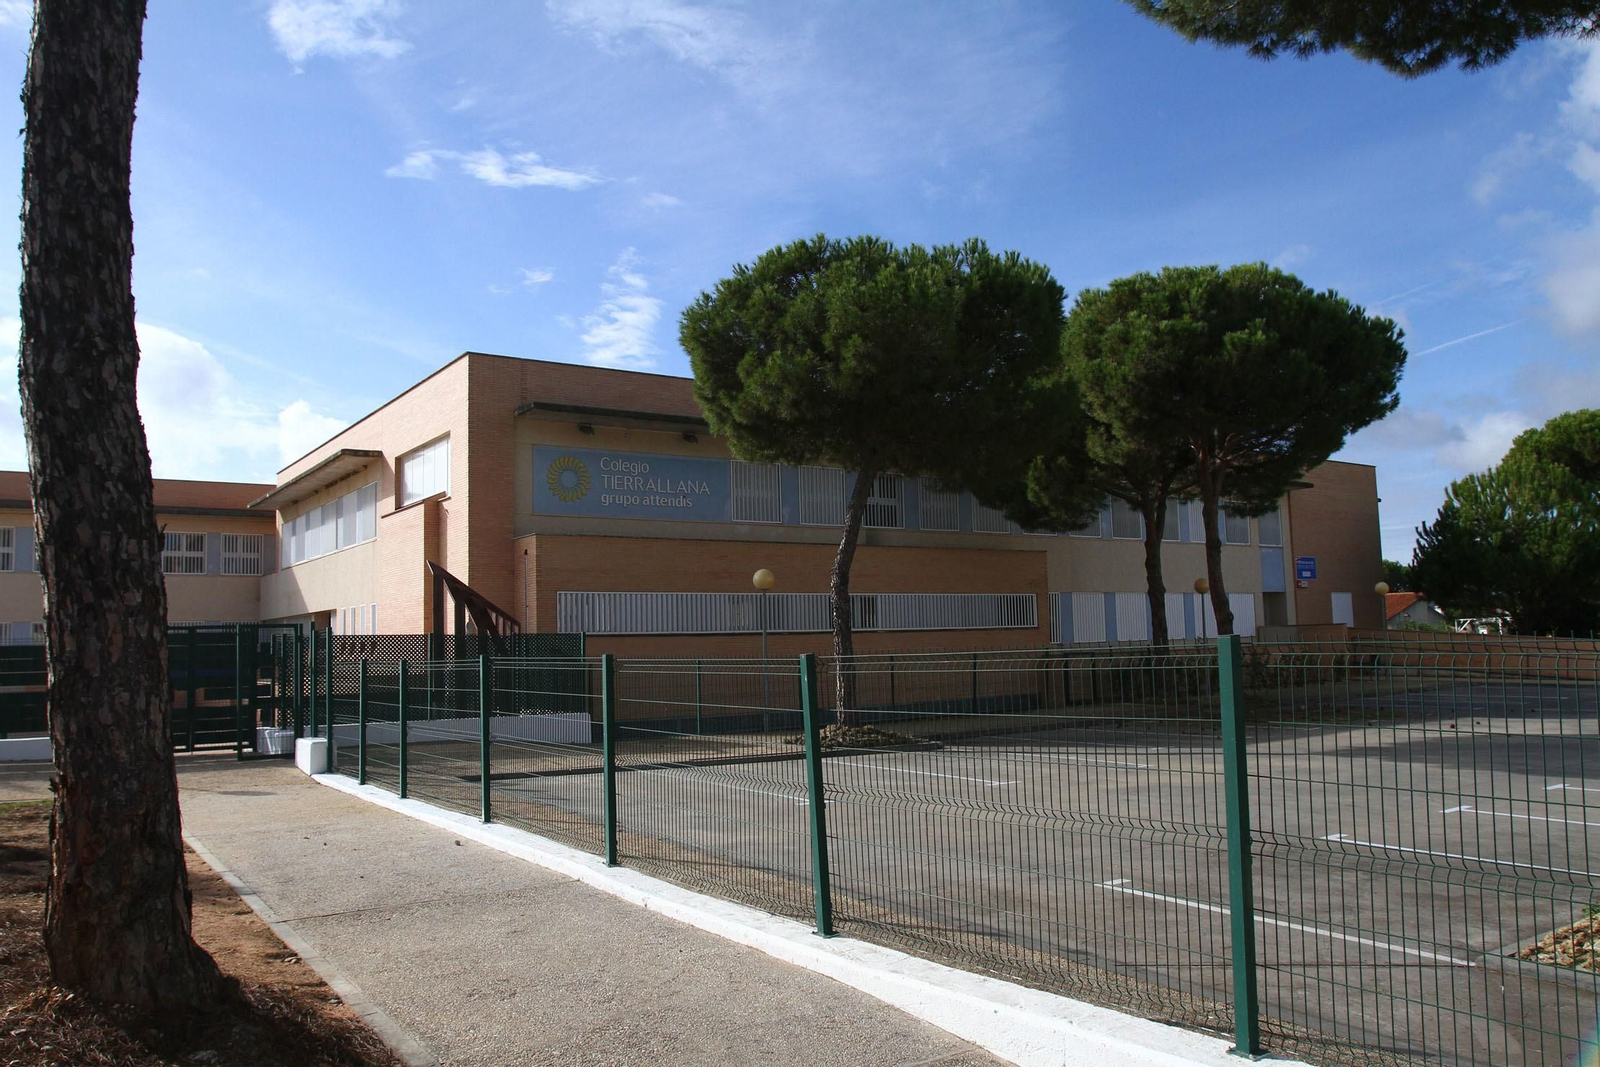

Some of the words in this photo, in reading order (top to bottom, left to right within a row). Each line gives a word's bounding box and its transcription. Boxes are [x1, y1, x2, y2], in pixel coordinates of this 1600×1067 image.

[600, 457, 649, 475] Colegio
[601, 474, 710, 495] TIERRALLANA
[601, 494, 639, 506] grupo
[643, 494, 693, 507] attendis
